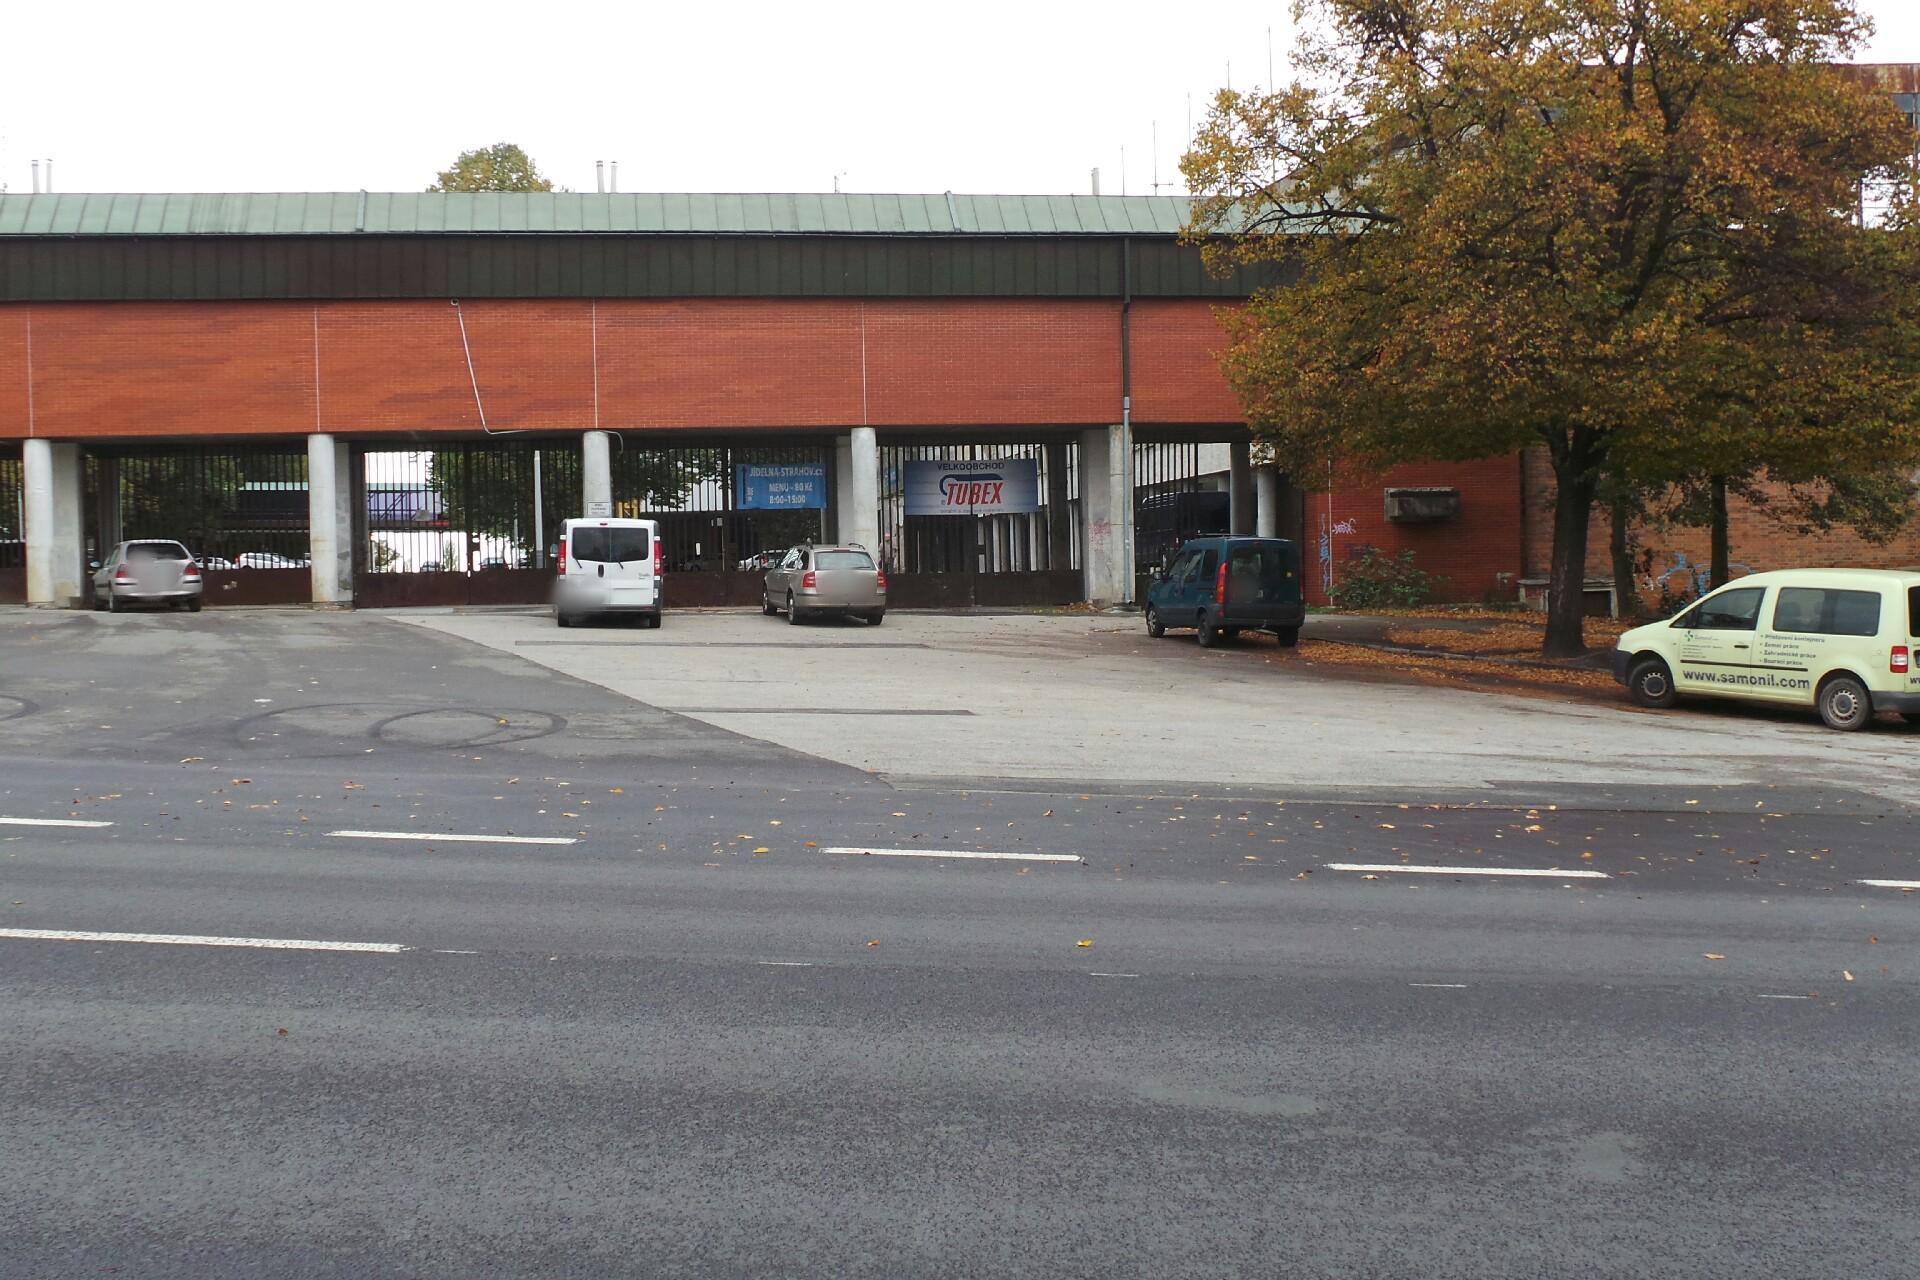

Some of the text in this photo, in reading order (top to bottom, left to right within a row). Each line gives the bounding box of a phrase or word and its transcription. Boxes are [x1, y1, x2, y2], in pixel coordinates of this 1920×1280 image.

[937, 462, 1005, 471] VELKOOBCHOD
[768, 483, 789, 492] MENU
[947, 482, 1004, 505] TUBEX
[769, 495, 806, 504] 8:00-15:00
[1682, 669, 1810, 689] www.samonil.com
